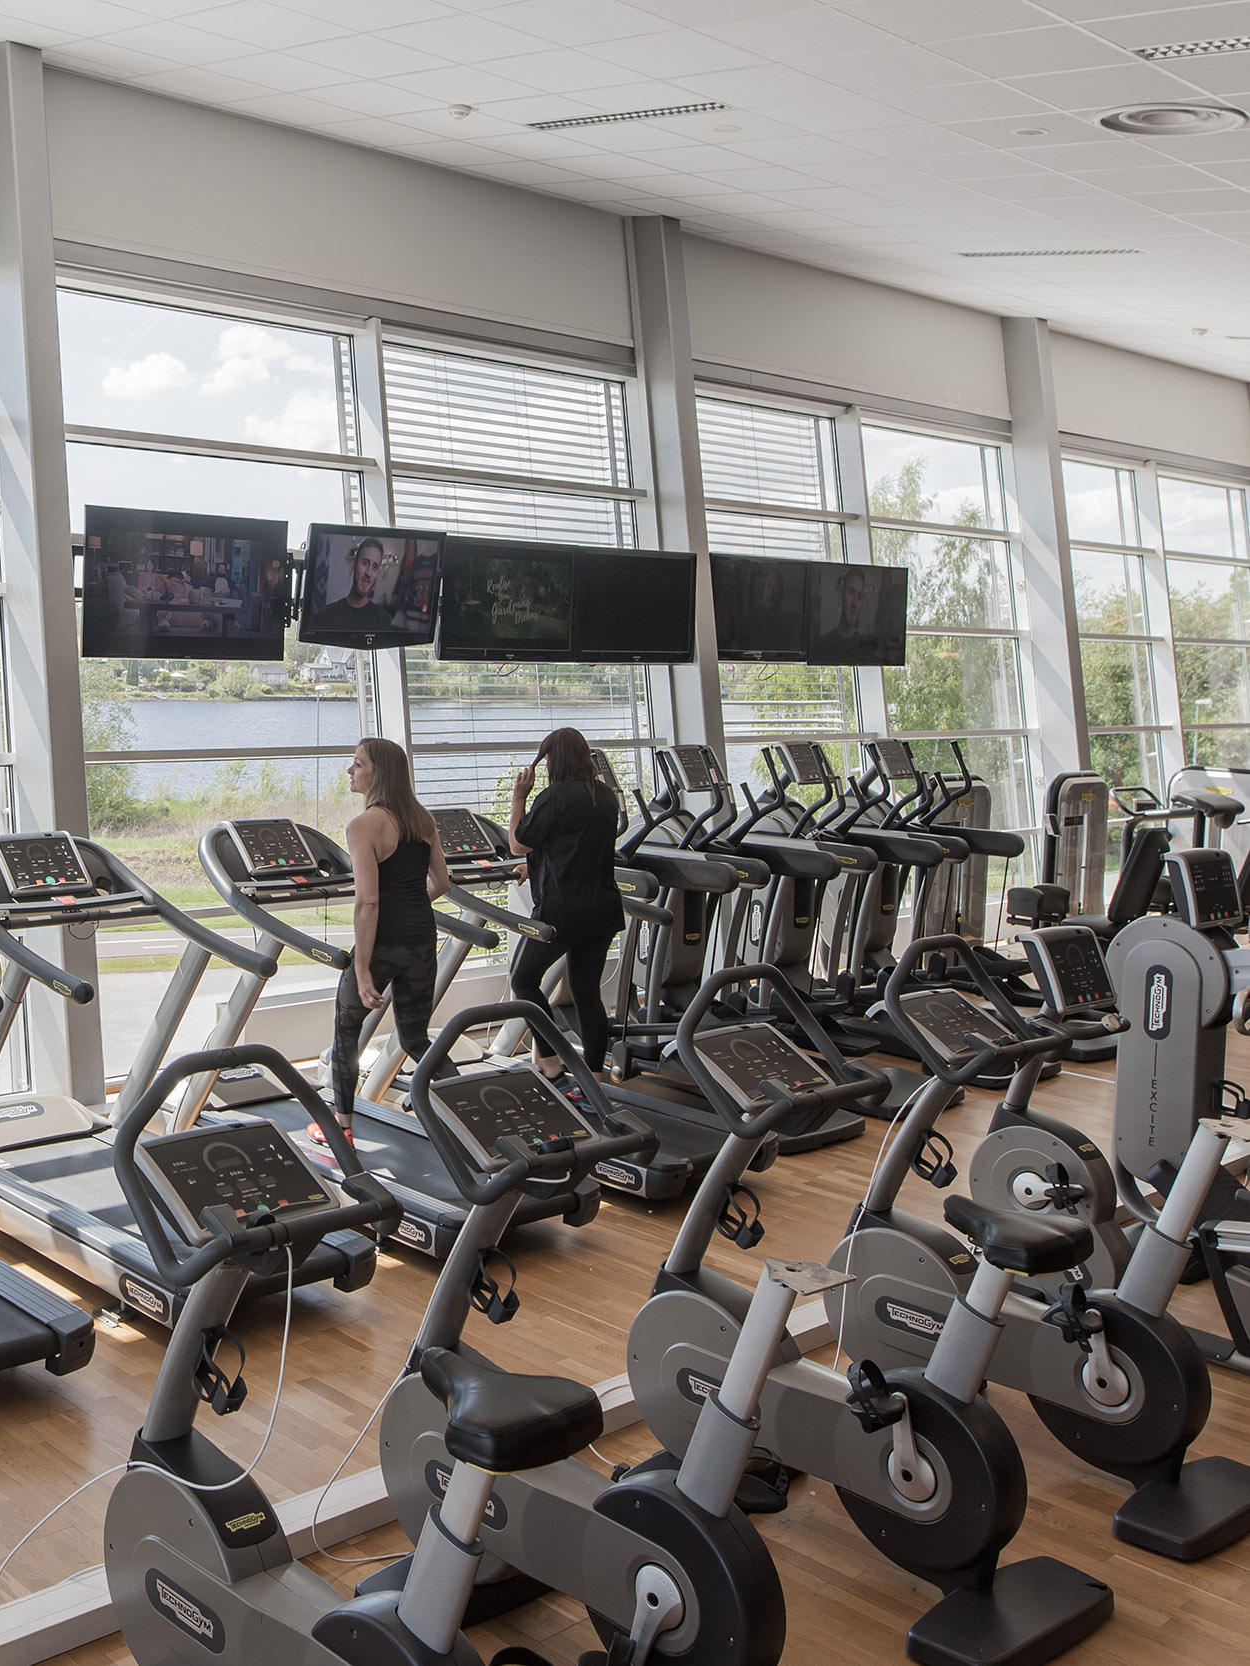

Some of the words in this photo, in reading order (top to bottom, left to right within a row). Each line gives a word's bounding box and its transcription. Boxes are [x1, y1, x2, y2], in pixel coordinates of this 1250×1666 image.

[1149, 973, 1167, 1031] TECHNOGYM
[1148, 1079, 1158, 1147] EXCITE
[887, 1303, 945, 1334] TECHNOGYM
[156, 1578, 214, 1639] TECHNOGYM
